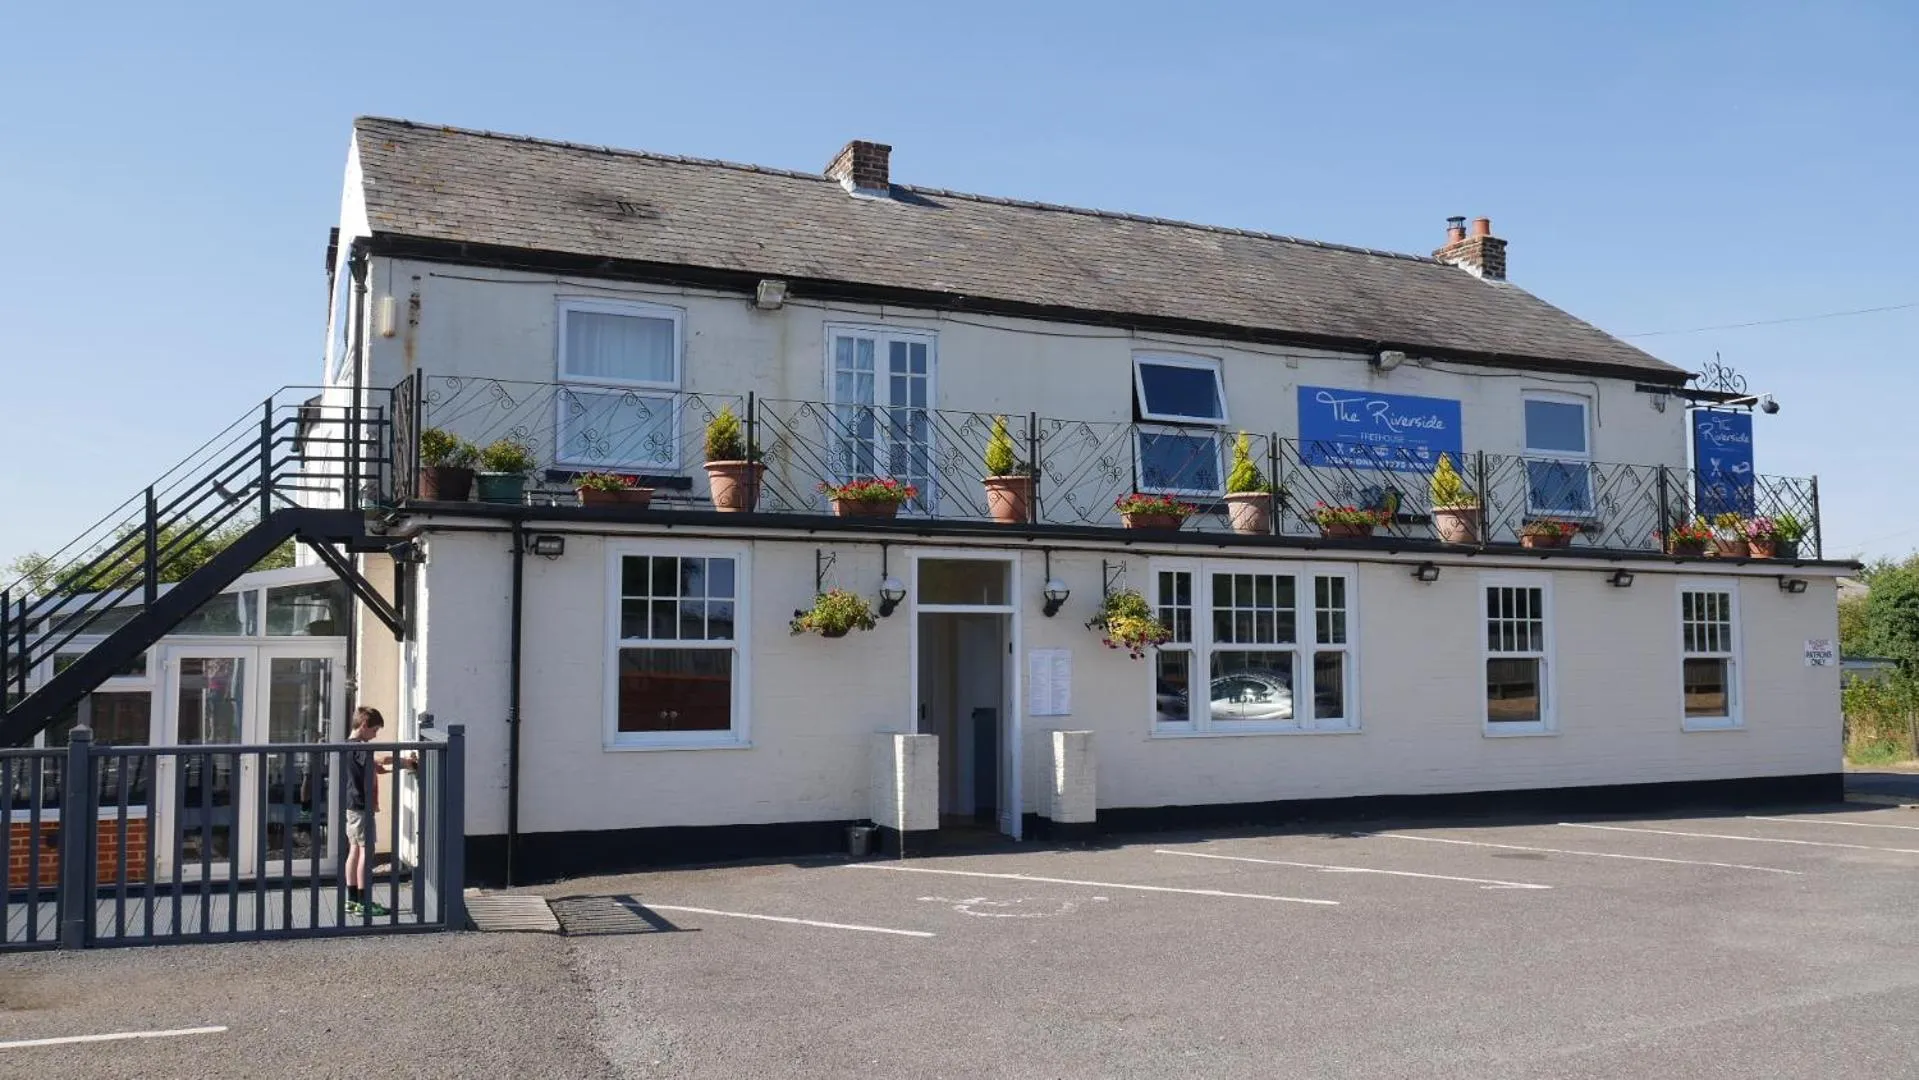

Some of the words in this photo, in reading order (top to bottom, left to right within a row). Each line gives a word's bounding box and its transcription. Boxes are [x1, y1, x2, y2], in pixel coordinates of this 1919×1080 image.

[1316, 391, 1366, 422] The
[1366, 400, 1447, 433] Riverside
[1698, 422, 1750, 446] Riverside
[1811, 658, 1825, 666] ONLY
